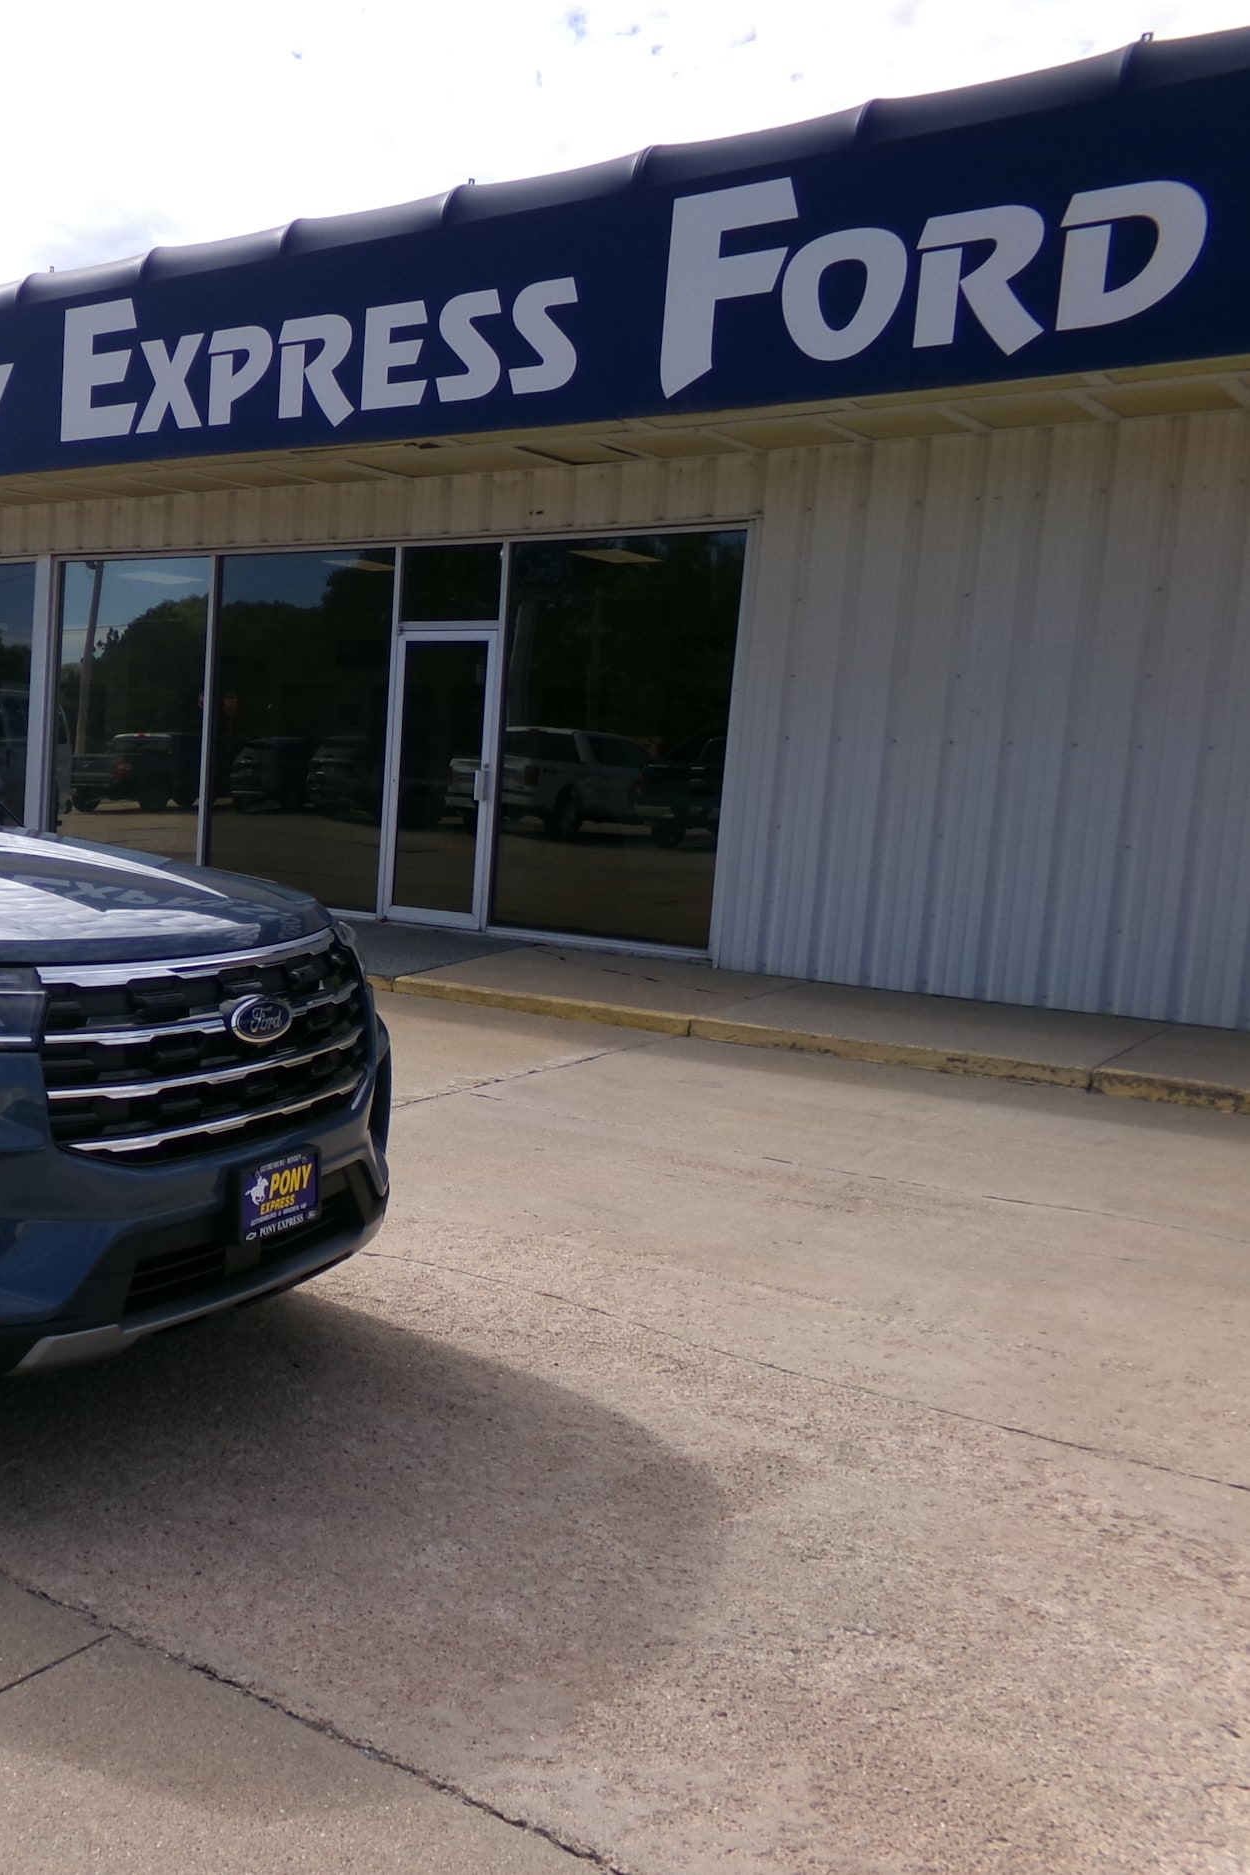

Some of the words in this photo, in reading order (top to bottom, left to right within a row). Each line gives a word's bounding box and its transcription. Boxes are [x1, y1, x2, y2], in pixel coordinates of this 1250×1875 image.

[60, 276, 579, 443] EXPRESS
[660, 177, 1211, 399] FORD
[250, 1006, 283, 1033] Ford
[268, 1163, 313, 1199] PONY
[260, 1194, 296, 1216] EXPRESS
